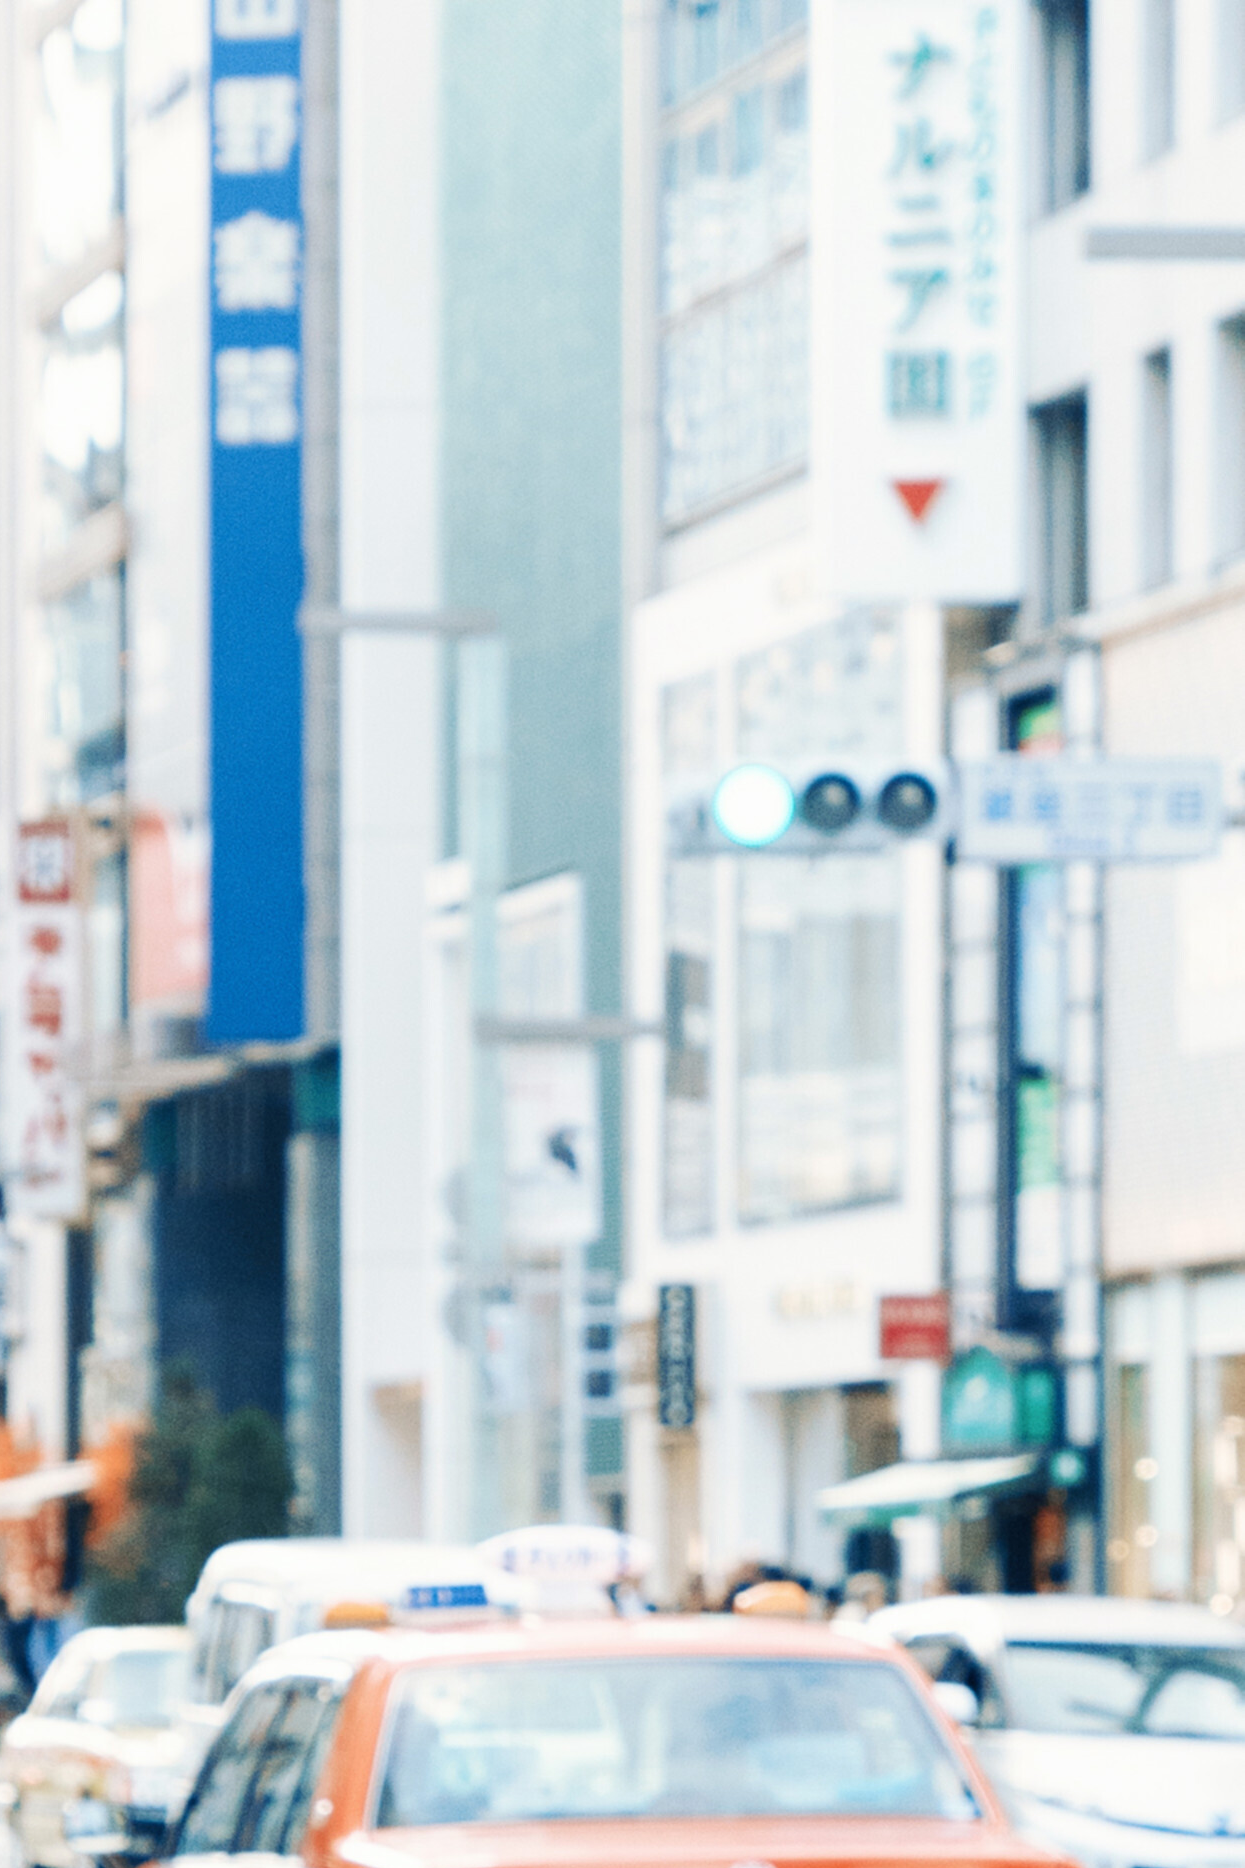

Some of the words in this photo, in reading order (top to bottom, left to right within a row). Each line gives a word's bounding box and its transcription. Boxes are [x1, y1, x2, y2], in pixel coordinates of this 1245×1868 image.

[886, 31, 955, 421] ナルニア国
